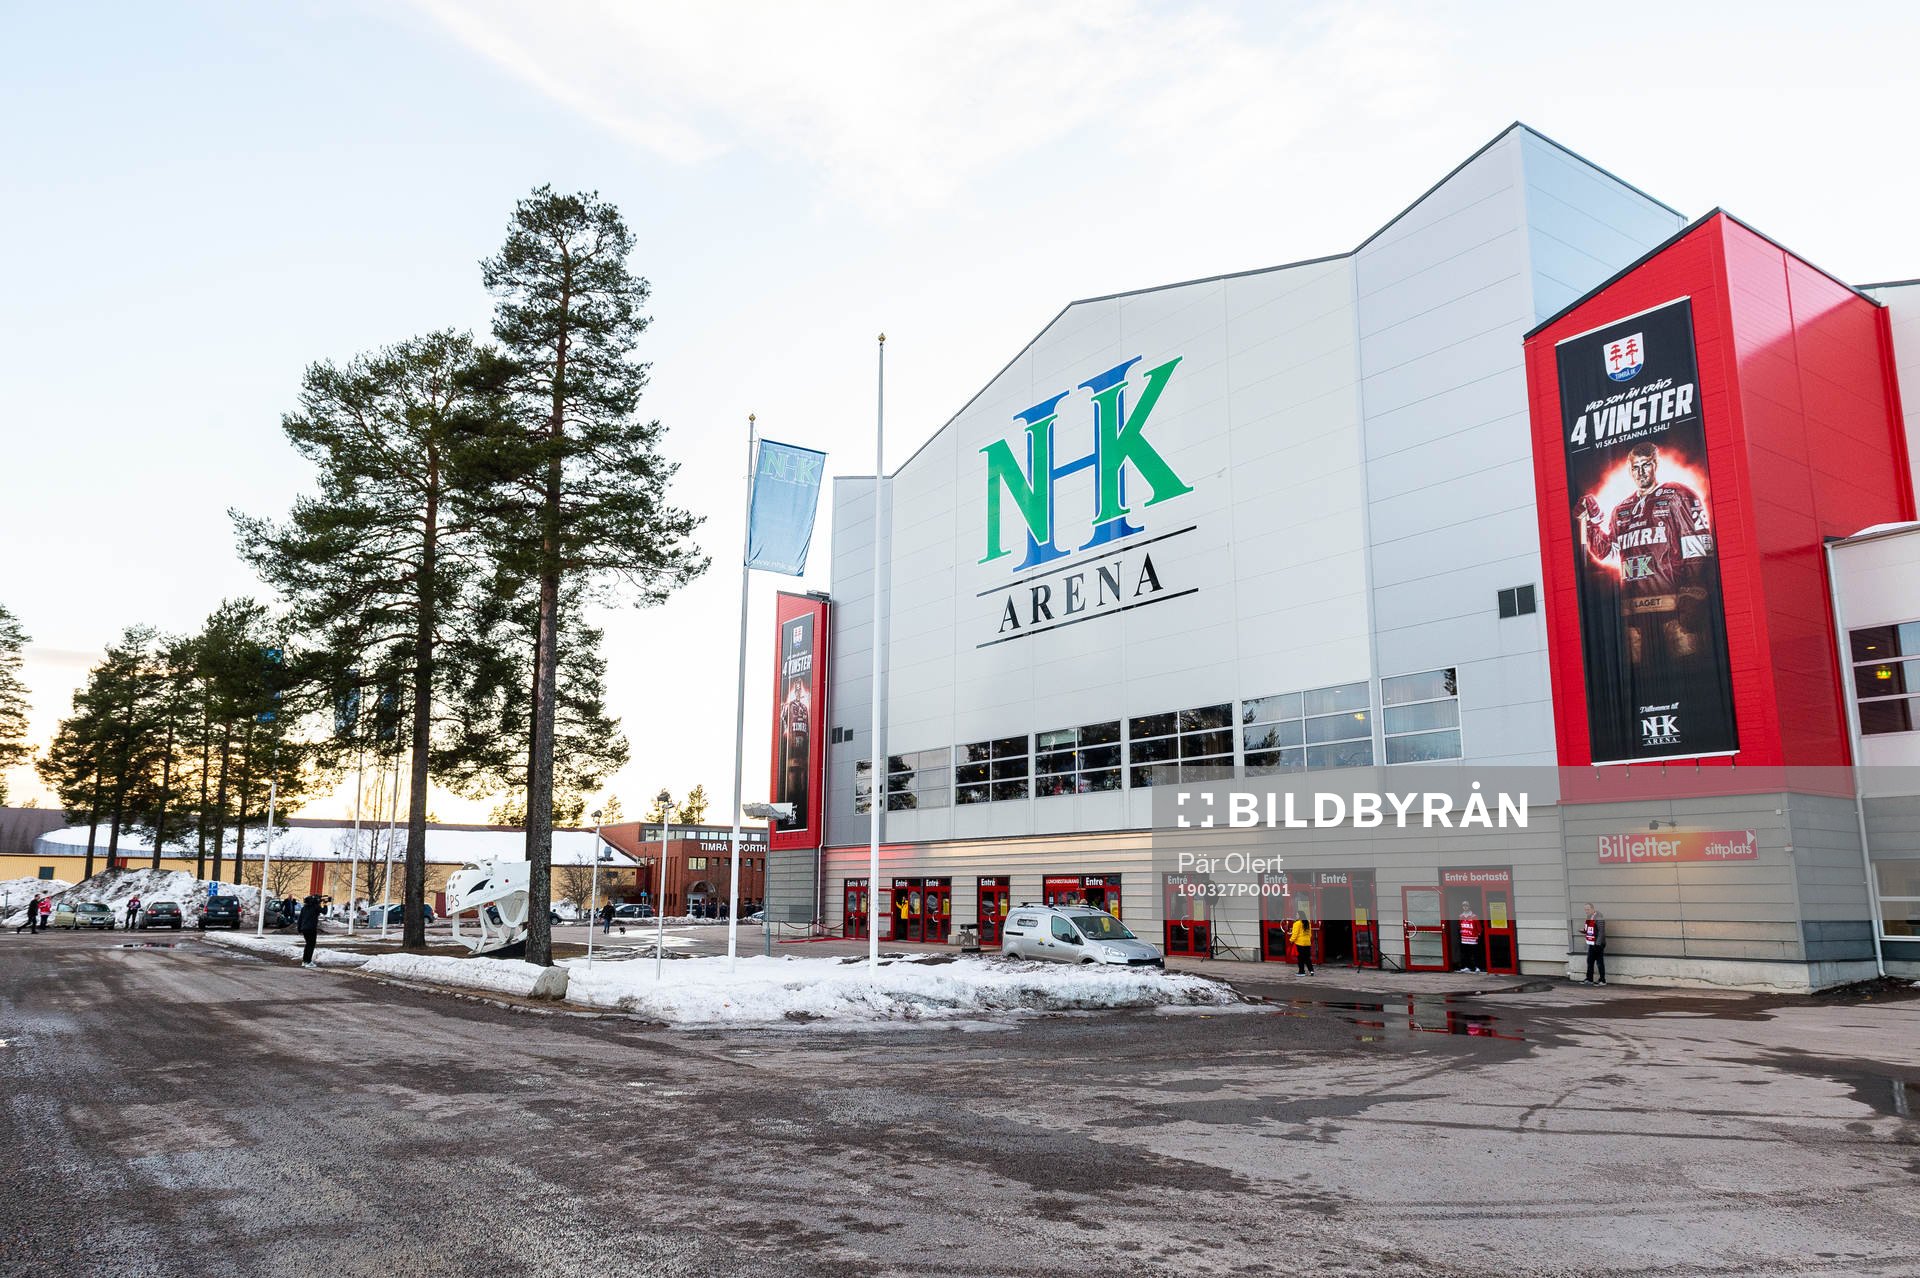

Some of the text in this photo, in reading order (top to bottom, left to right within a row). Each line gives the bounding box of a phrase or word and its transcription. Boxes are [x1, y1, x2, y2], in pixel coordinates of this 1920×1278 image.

[1585, 378, 1672, 412] VAD SOM ÄN KRÄVS
[1570, 383, 1694, 445] 4 VINSTER
[1595, 441, 1603, 449] VI
[1604, 438, 1618, 447] SKA
[1618, 430, 1649, 443] STANNA
[1654, 422, 1670, 432] SHL!
[978, 355, 1194, 573] NHK
[1617, 521, 1667, 551] TIMRÅ
[998, 552, 1164, 633] ARENA
[1641, 715, 1680, 738] NHK
[1647, 737, 1677, 745] ARENA
[700, 841, 767, 853] TIMRÅ PORTH
[1599, 835, 1753, 863] Biljetter sittplats
[981, 878, 996, 887] Entré
[1085, 876, 1104, 886] Entré
[1167, 874, 1188, 885] Entré
[1263, 873, 1288, 884] Entré
[1321, 872, 1347, 884] Entré
[1445, 871, 1509, 882] Entré bortastå
[926, 879, 939, 887] Entré
